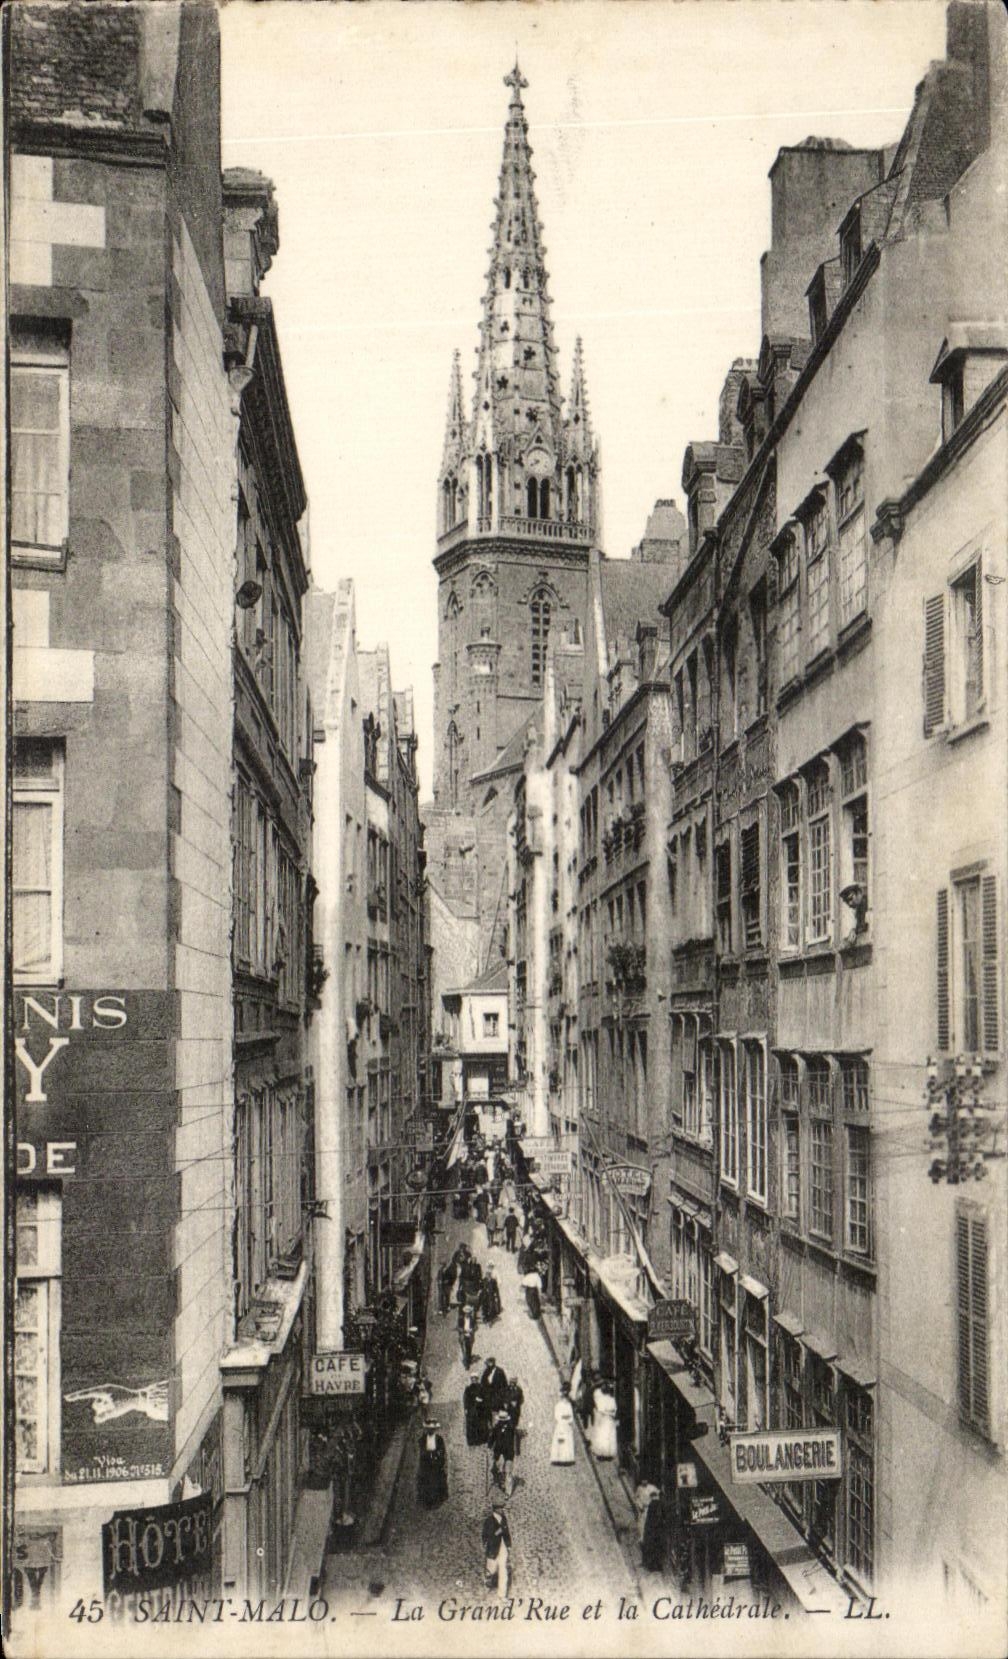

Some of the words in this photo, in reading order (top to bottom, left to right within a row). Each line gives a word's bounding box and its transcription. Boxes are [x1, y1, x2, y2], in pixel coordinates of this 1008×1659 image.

[21, 996, 127, 1030] NIS
[15, 1037, 70, 1102] Y
[315, 1380, 361, 1393] HAVRE
[736, 1440, 836, 1473] BOULANGERIE
